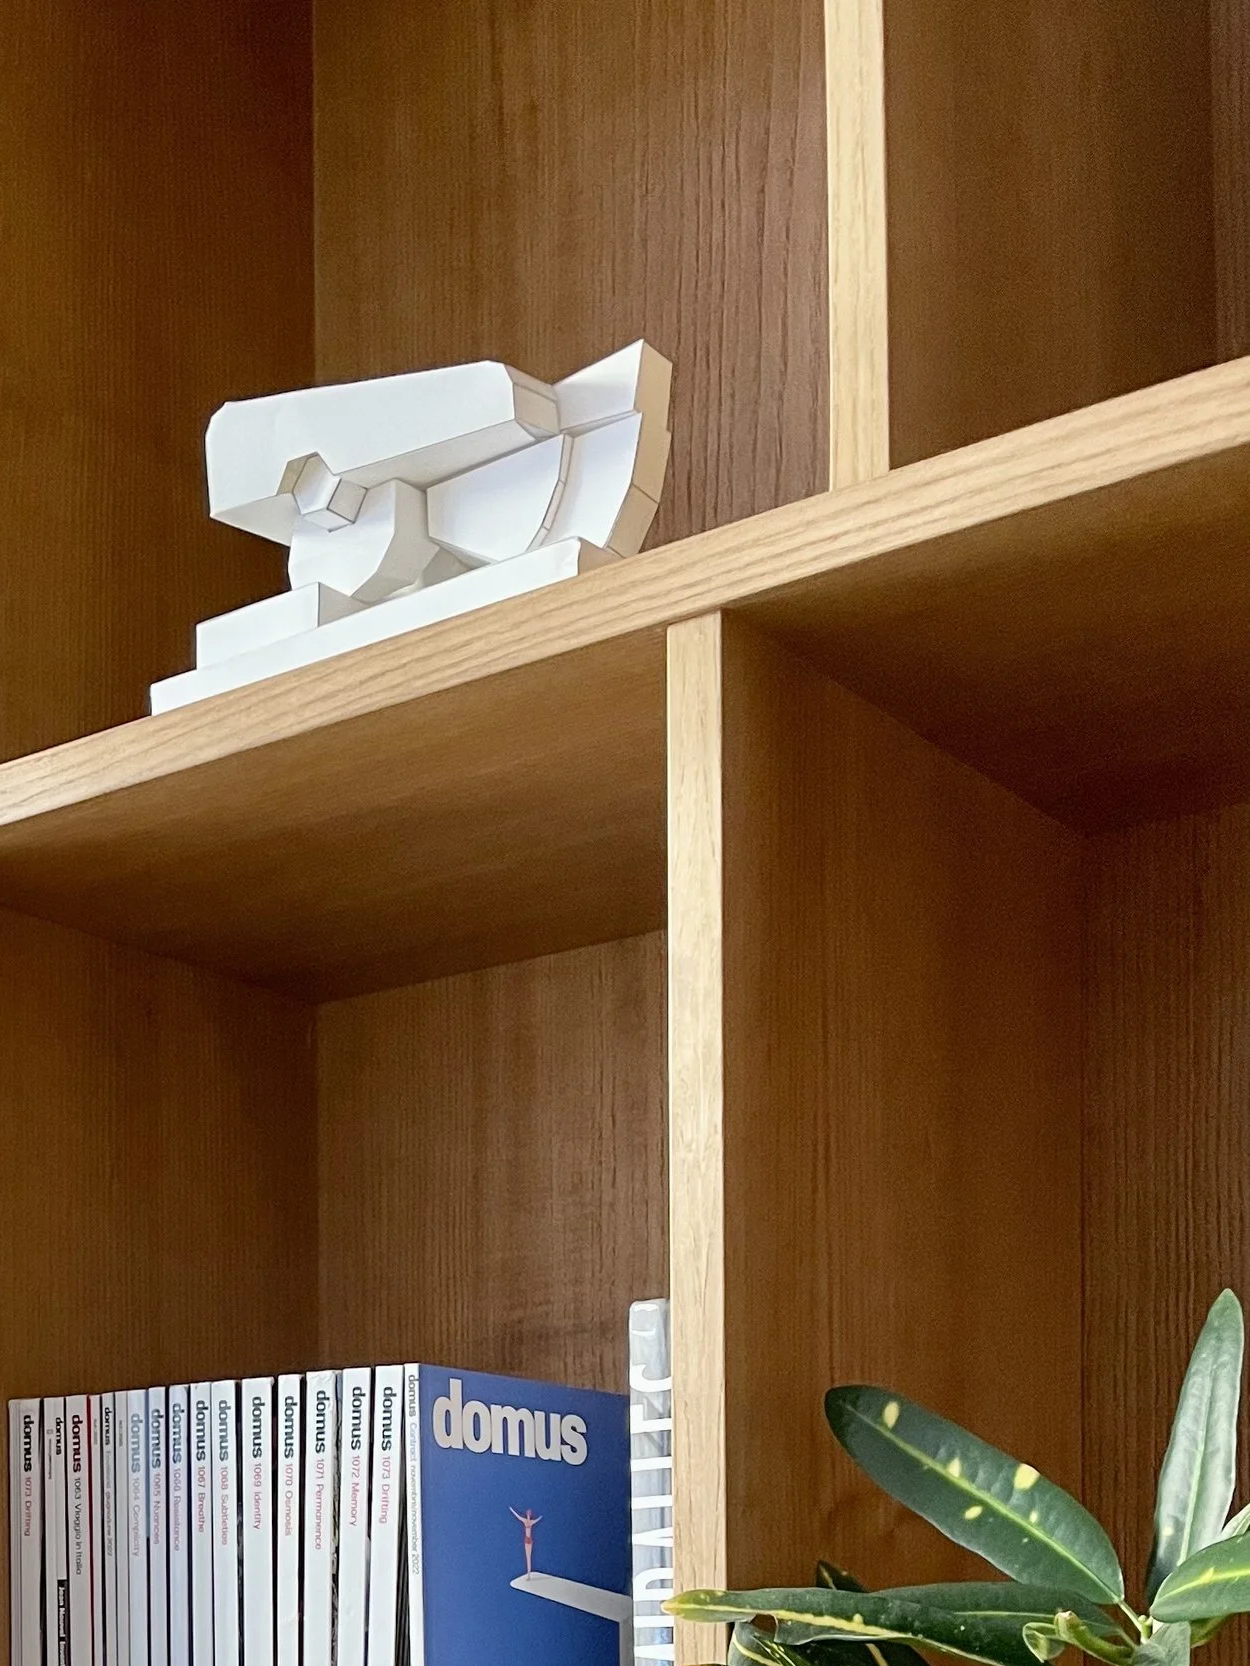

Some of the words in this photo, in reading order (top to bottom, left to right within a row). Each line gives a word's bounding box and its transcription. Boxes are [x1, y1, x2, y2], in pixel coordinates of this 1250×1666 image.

[350, 1386, 366, 1451] domus
[407, 1374, 420, 1418] domus
[55, 1417, 64, 1455] domus
[104, 1407, 113, 1446] domus
[151, 1408, 164, 1470] domus
[172, 1403, 185, 1465] domus
[196, 1400, 209, 1462] domus
[218, 1399, 231, 1463] domus
[252, 1396, 266, 1460] domus
[284, 1395, 298, 1460] domus
[315, 1390, 330, 1454] domus
[381, 1386, 397, 1452] domus
[433, 1378, 588, 1466] domus
[23, 1414, 35, 1473] domus
[71, 1414, 84, 1473] domus
[131, 1413, 144, 1474] domus
[197, 1466, 206, 1489] 1067
[220, 1466, 229, 1491] 1068
[253, 1463, 262, 1488] 1069
[285, 1463, 294, 1488] 1070
[316, 1459, 325, 1482] 1071
[351, 1454, 361, 1480] 1072
[381, 1455, 391, 1480] 1073
[73, 1502, 82, 1541] Viaggio
[197, 1492, 206, 1534] Breathe
[253, 1491, 262, 1531] Identity
[314, 1484, 325, 1551] Permanence
[349, 1482, 361, 1527] Memory
[378, 1483, 391, 1525] Drifting
